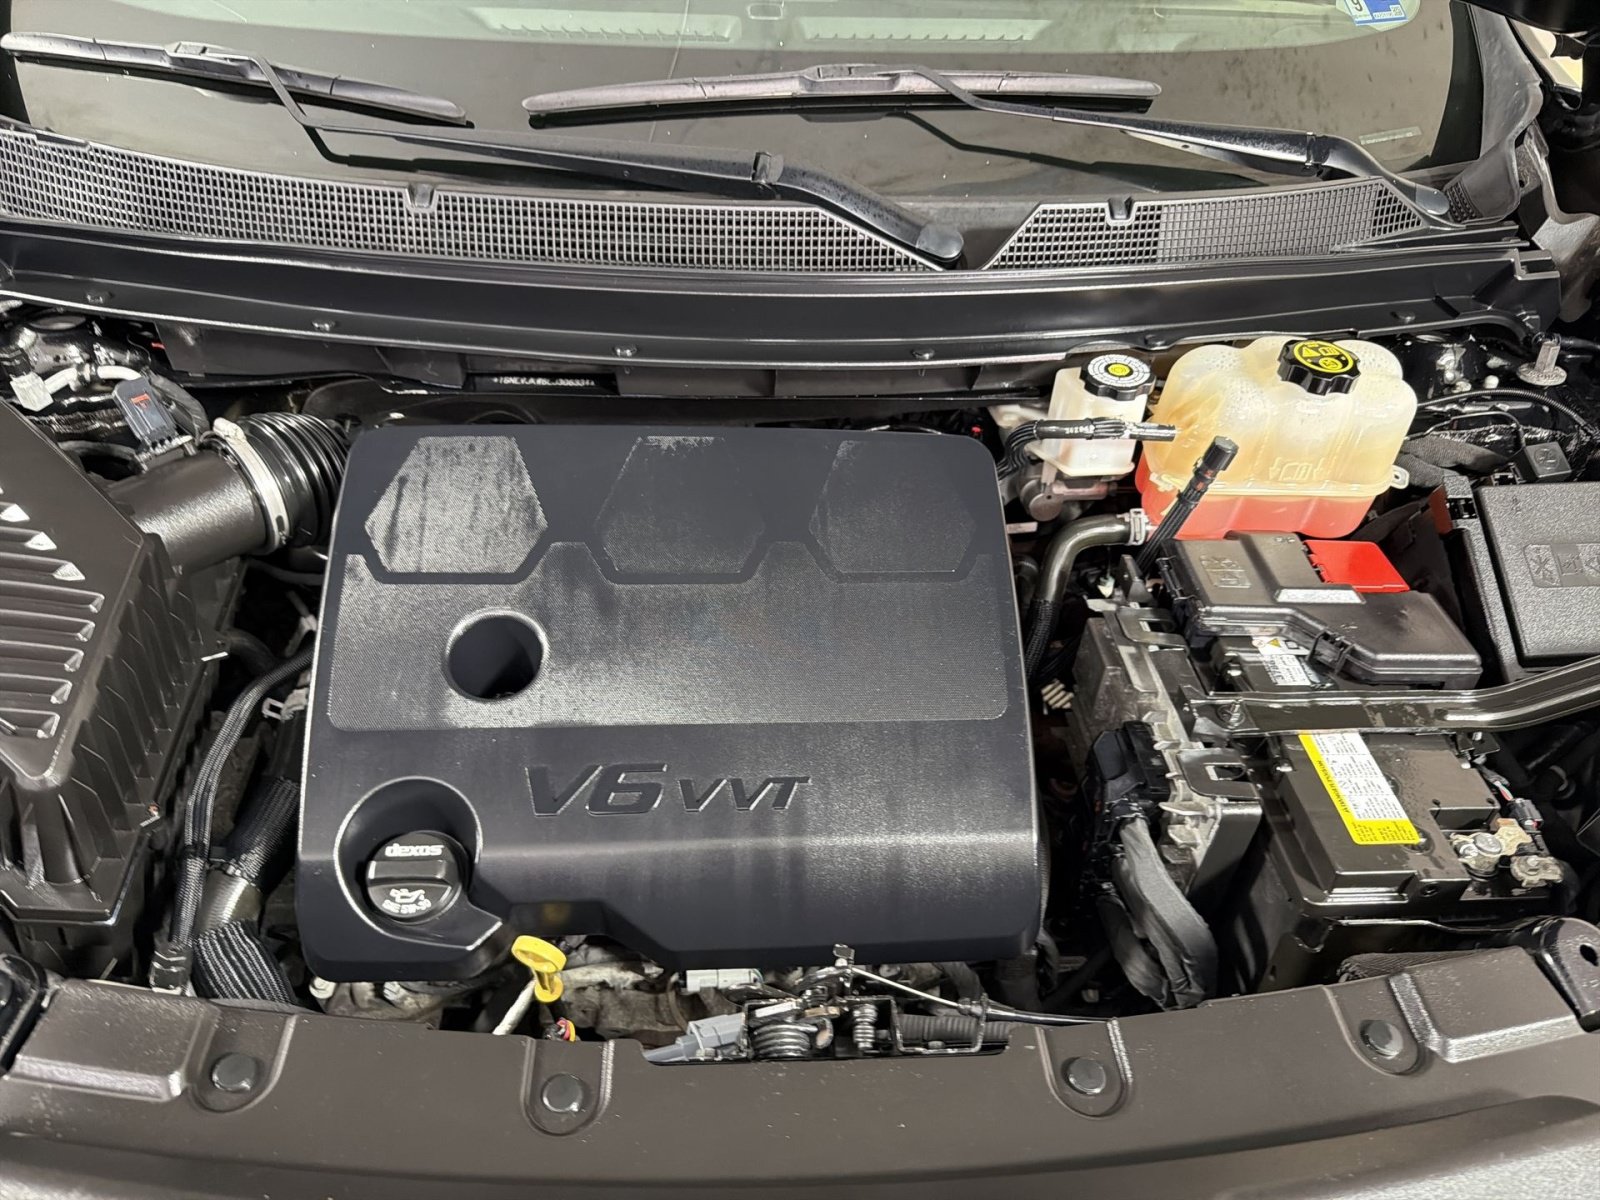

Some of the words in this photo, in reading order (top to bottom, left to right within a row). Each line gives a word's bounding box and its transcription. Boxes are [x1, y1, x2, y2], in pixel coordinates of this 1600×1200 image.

[525, 763, 668, 817] V6
[677, 776, 811, 812] VVT
[385, 843, 444, 857] dexos
